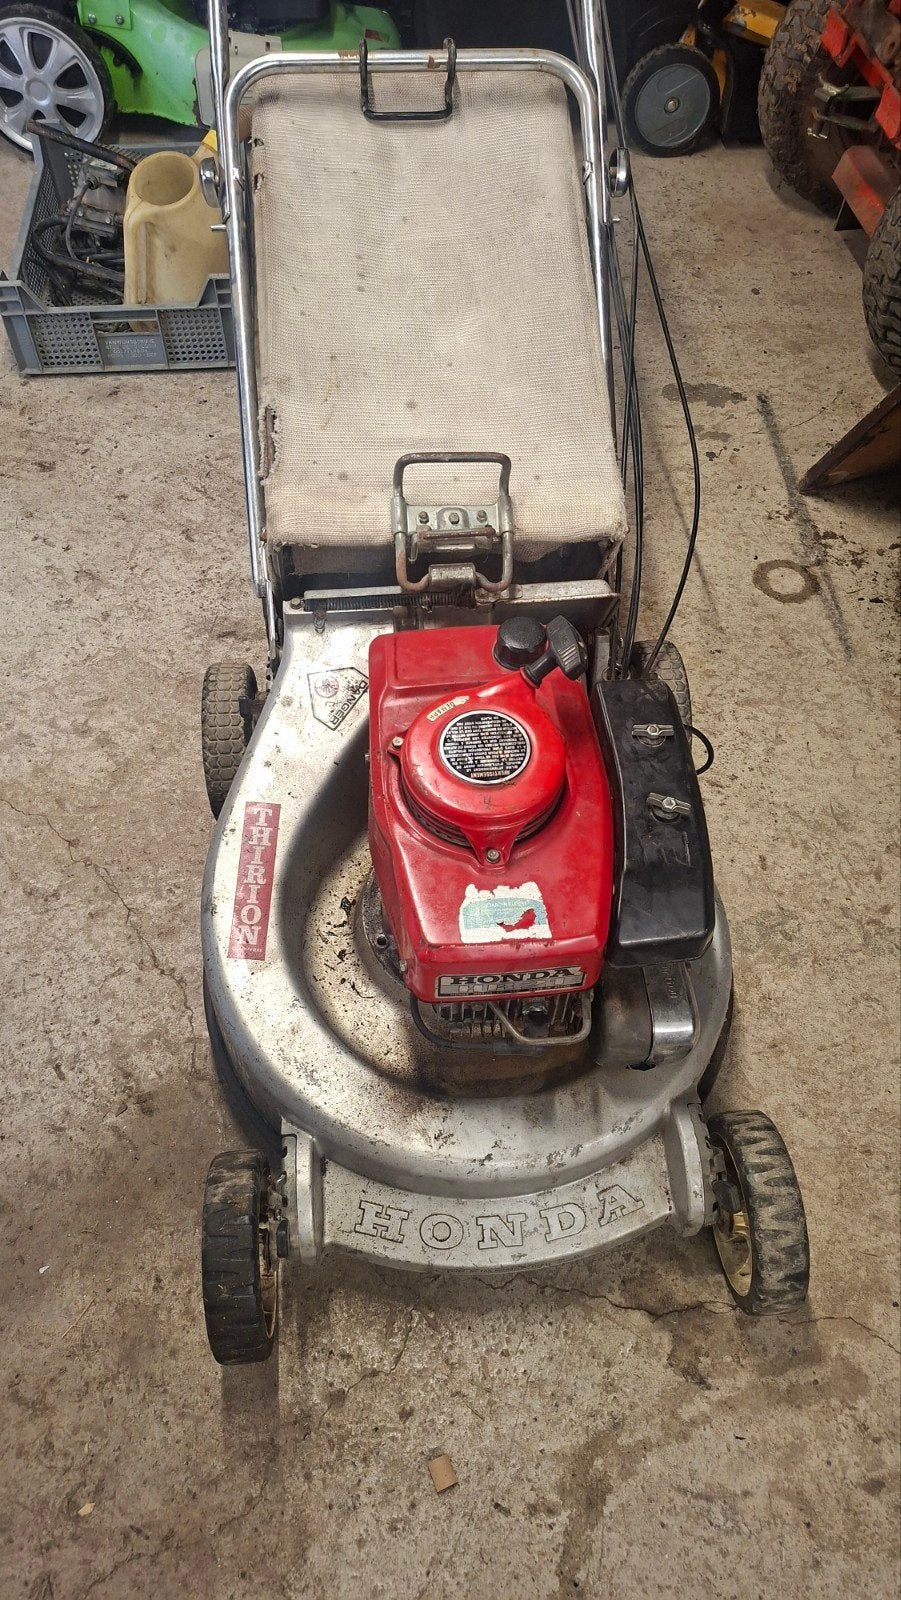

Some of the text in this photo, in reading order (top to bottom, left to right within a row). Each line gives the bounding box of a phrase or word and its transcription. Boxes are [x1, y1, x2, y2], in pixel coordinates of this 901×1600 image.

[330, 680, 368, 725] DANGER
[236, 808, 273, 945] THIRION
[450, 968, 575, 985] HONDA
[354, 1184, 646, 1250] HONDA
